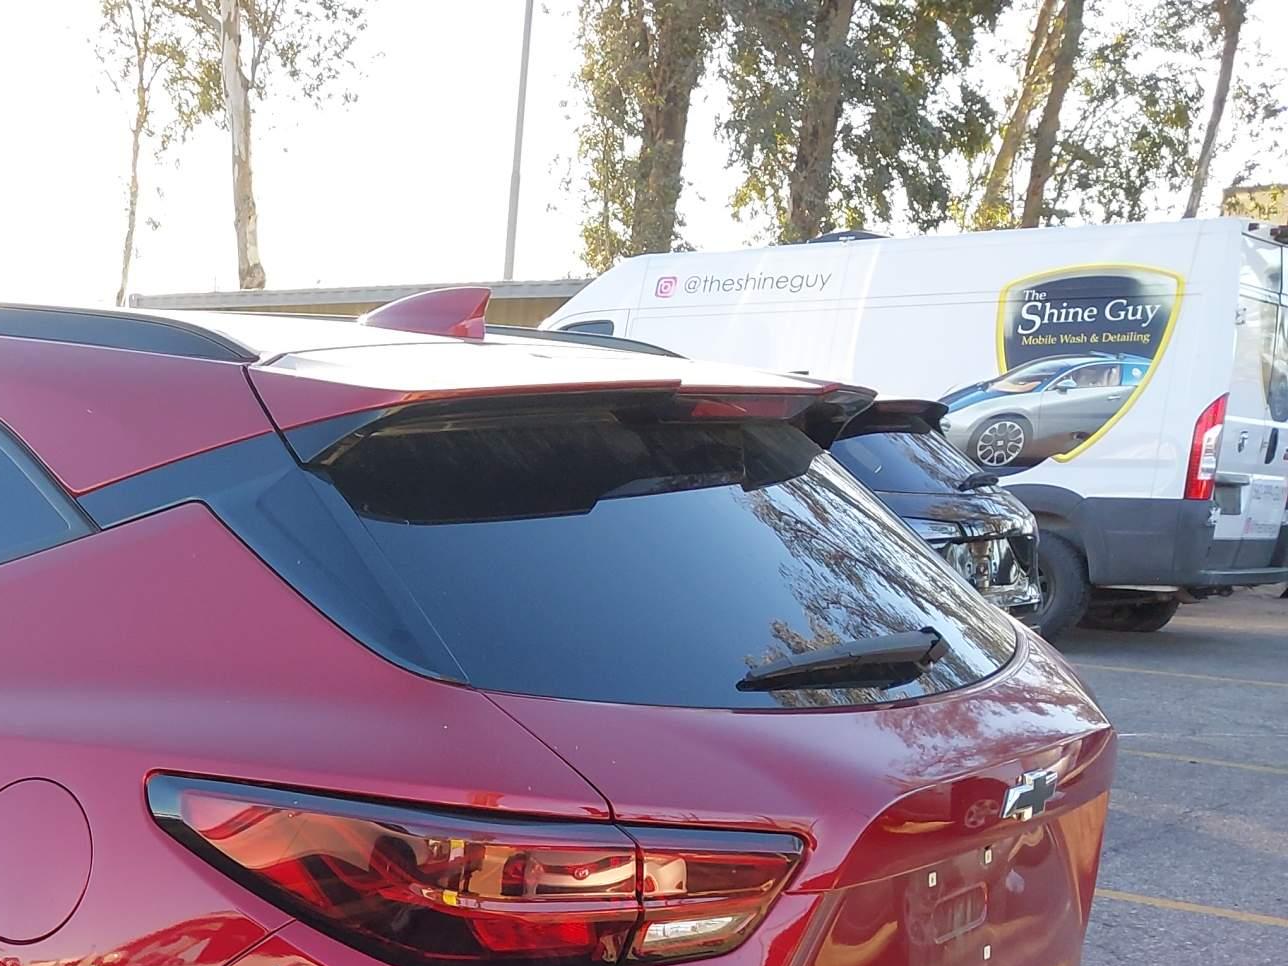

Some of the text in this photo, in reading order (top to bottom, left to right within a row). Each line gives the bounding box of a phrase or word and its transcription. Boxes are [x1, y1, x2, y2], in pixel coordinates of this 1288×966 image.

[684, 272, 832, 294] @theshineguy
[1024, 290, 1047, 301] The
[1017, 299, 1161, 334] Shine Guy
[1022, 332, 1151, 345] Mobile Wash & Detailing
